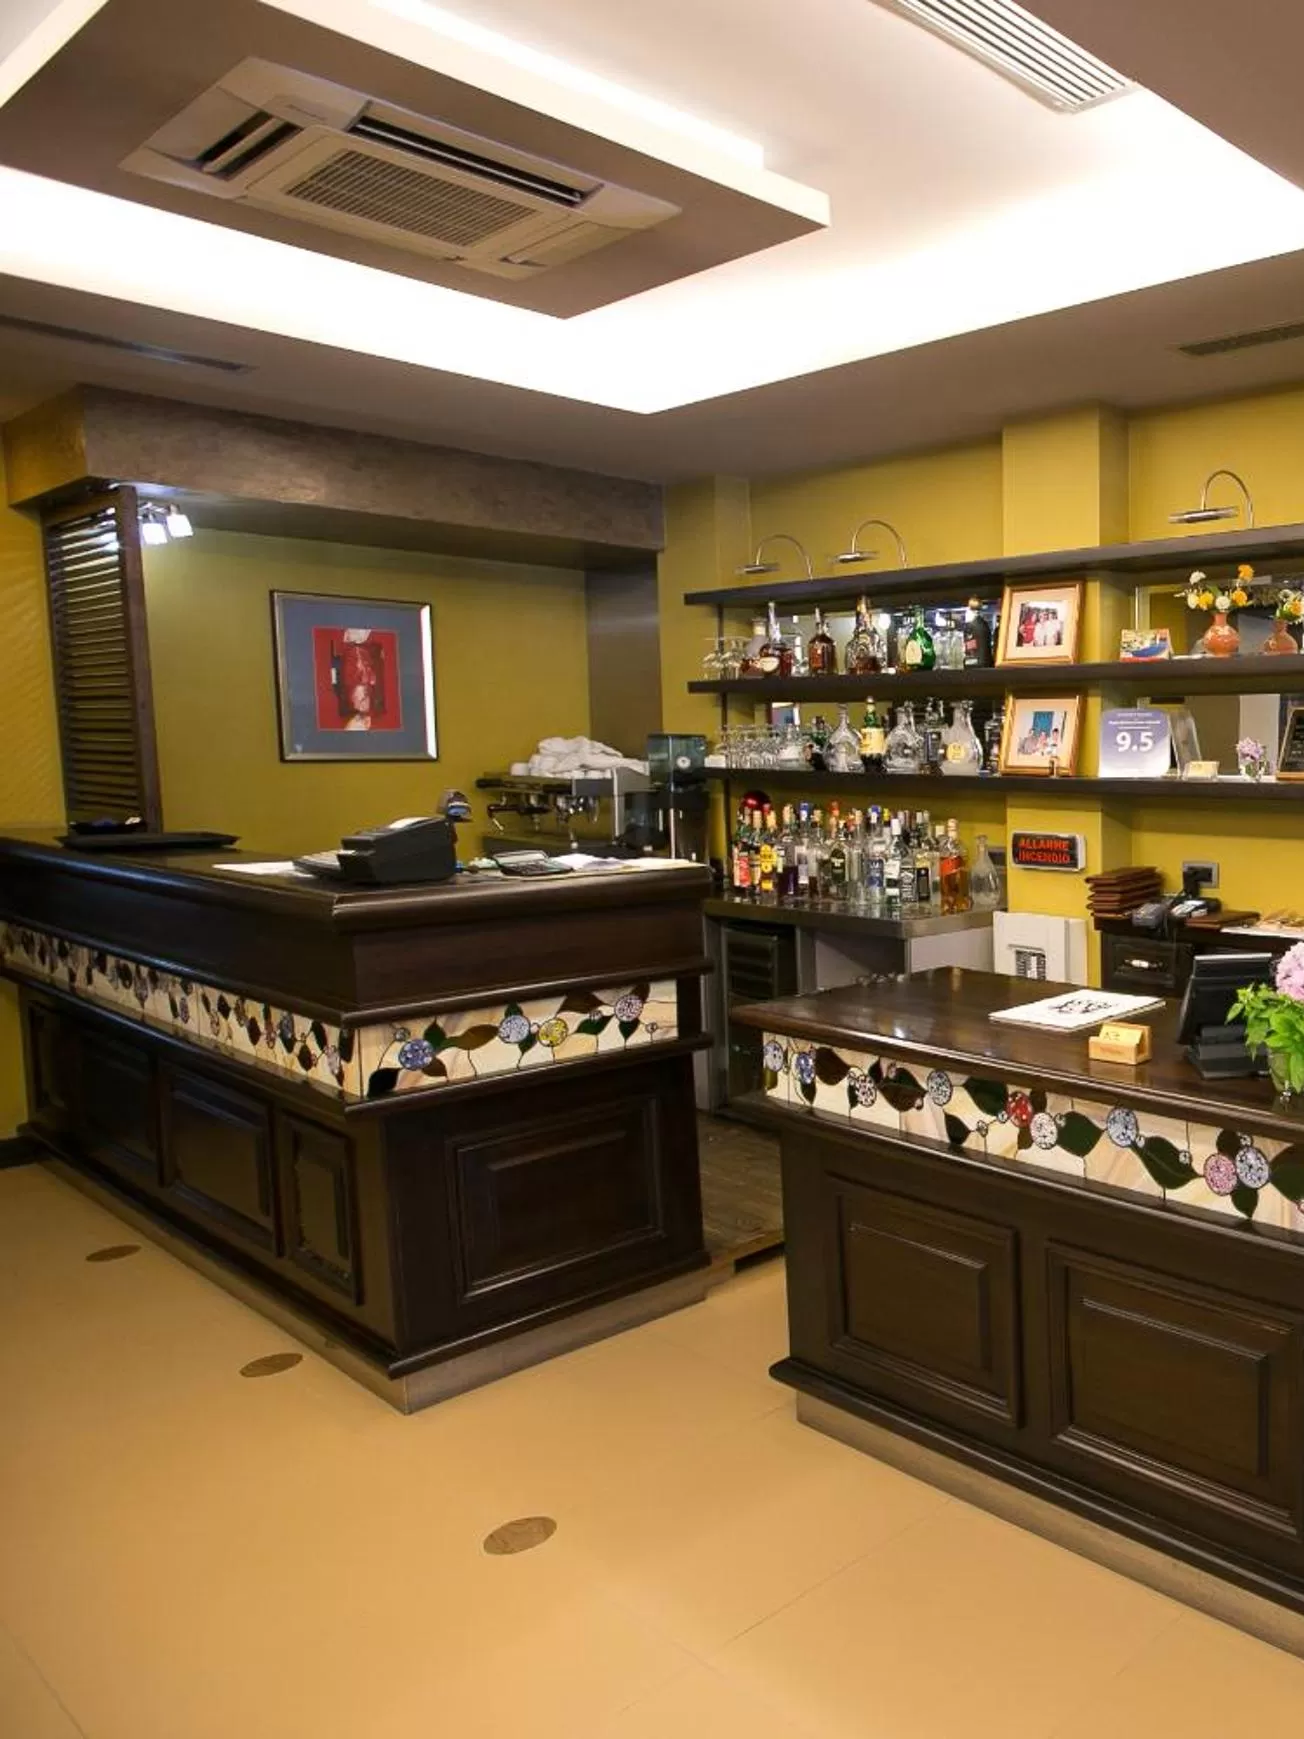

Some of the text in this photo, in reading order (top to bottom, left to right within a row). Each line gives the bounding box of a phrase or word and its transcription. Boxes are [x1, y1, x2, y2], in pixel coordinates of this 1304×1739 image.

[1116, 731, 1153, 752] 9.5
[1018, 837, 1070, 850] ALLARME
[1018, 849, 1071, 864] INCENDIO
